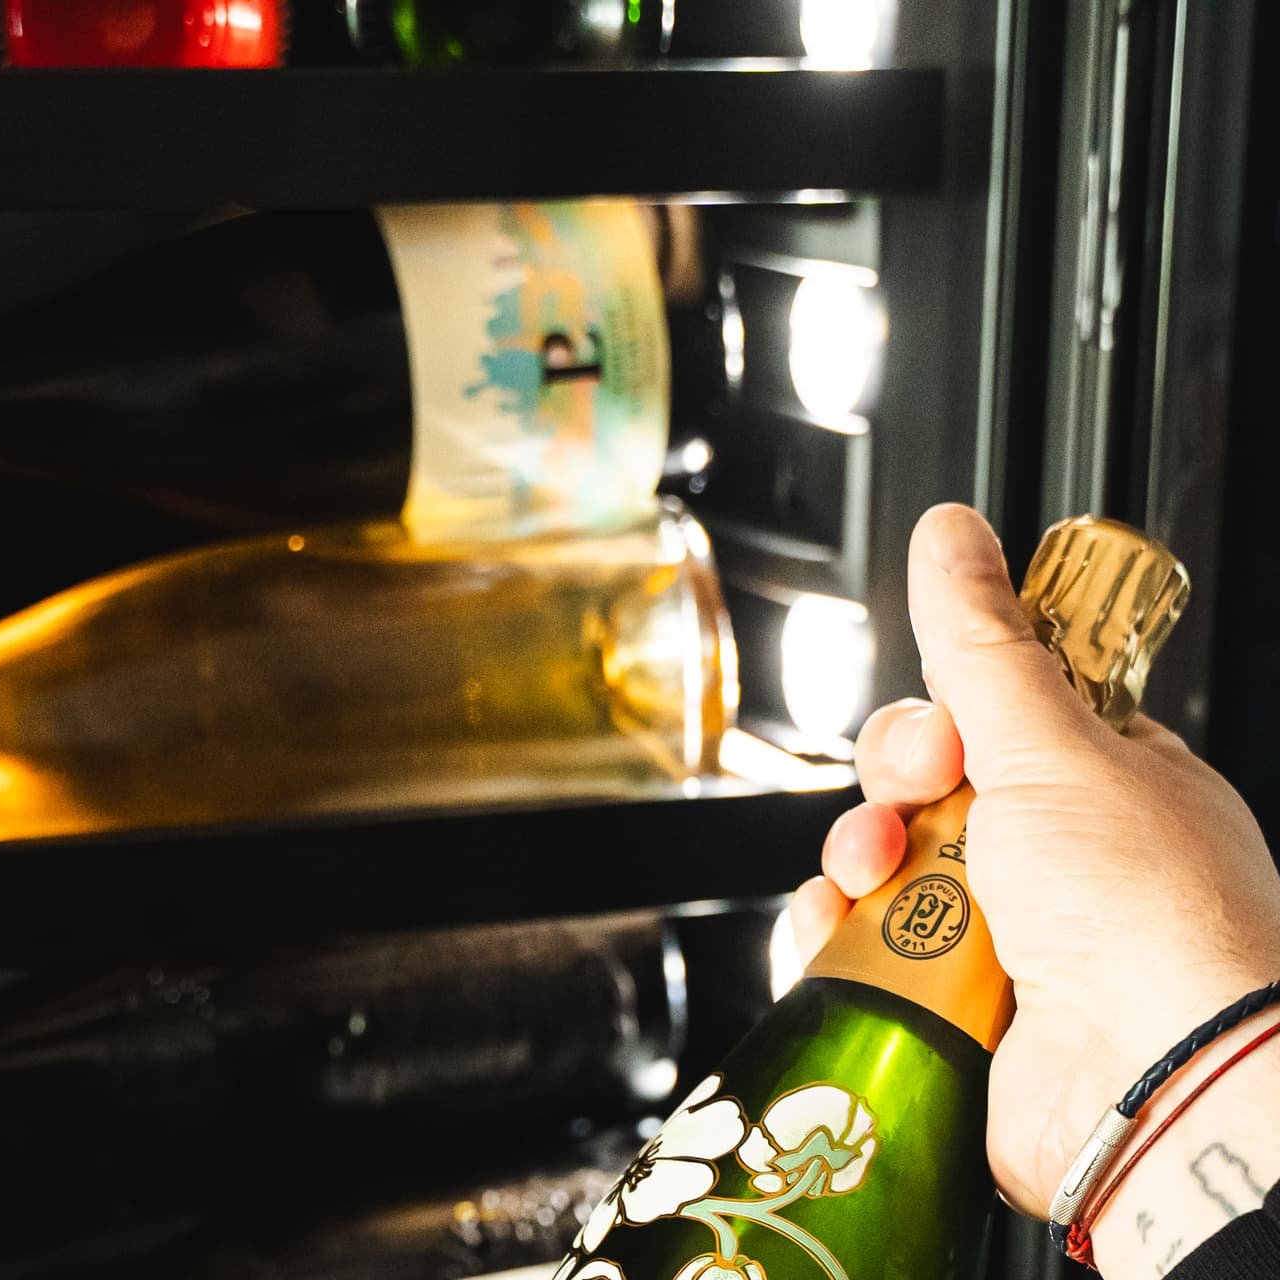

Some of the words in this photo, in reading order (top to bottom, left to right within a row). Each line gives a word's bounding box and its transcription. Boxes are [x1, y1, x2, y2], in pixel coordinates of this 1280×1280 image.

[921, 883, 958, 902] DEPUIS
[898, 892, 955, 939] PJ
[895, 934, 927, 951] 1811
